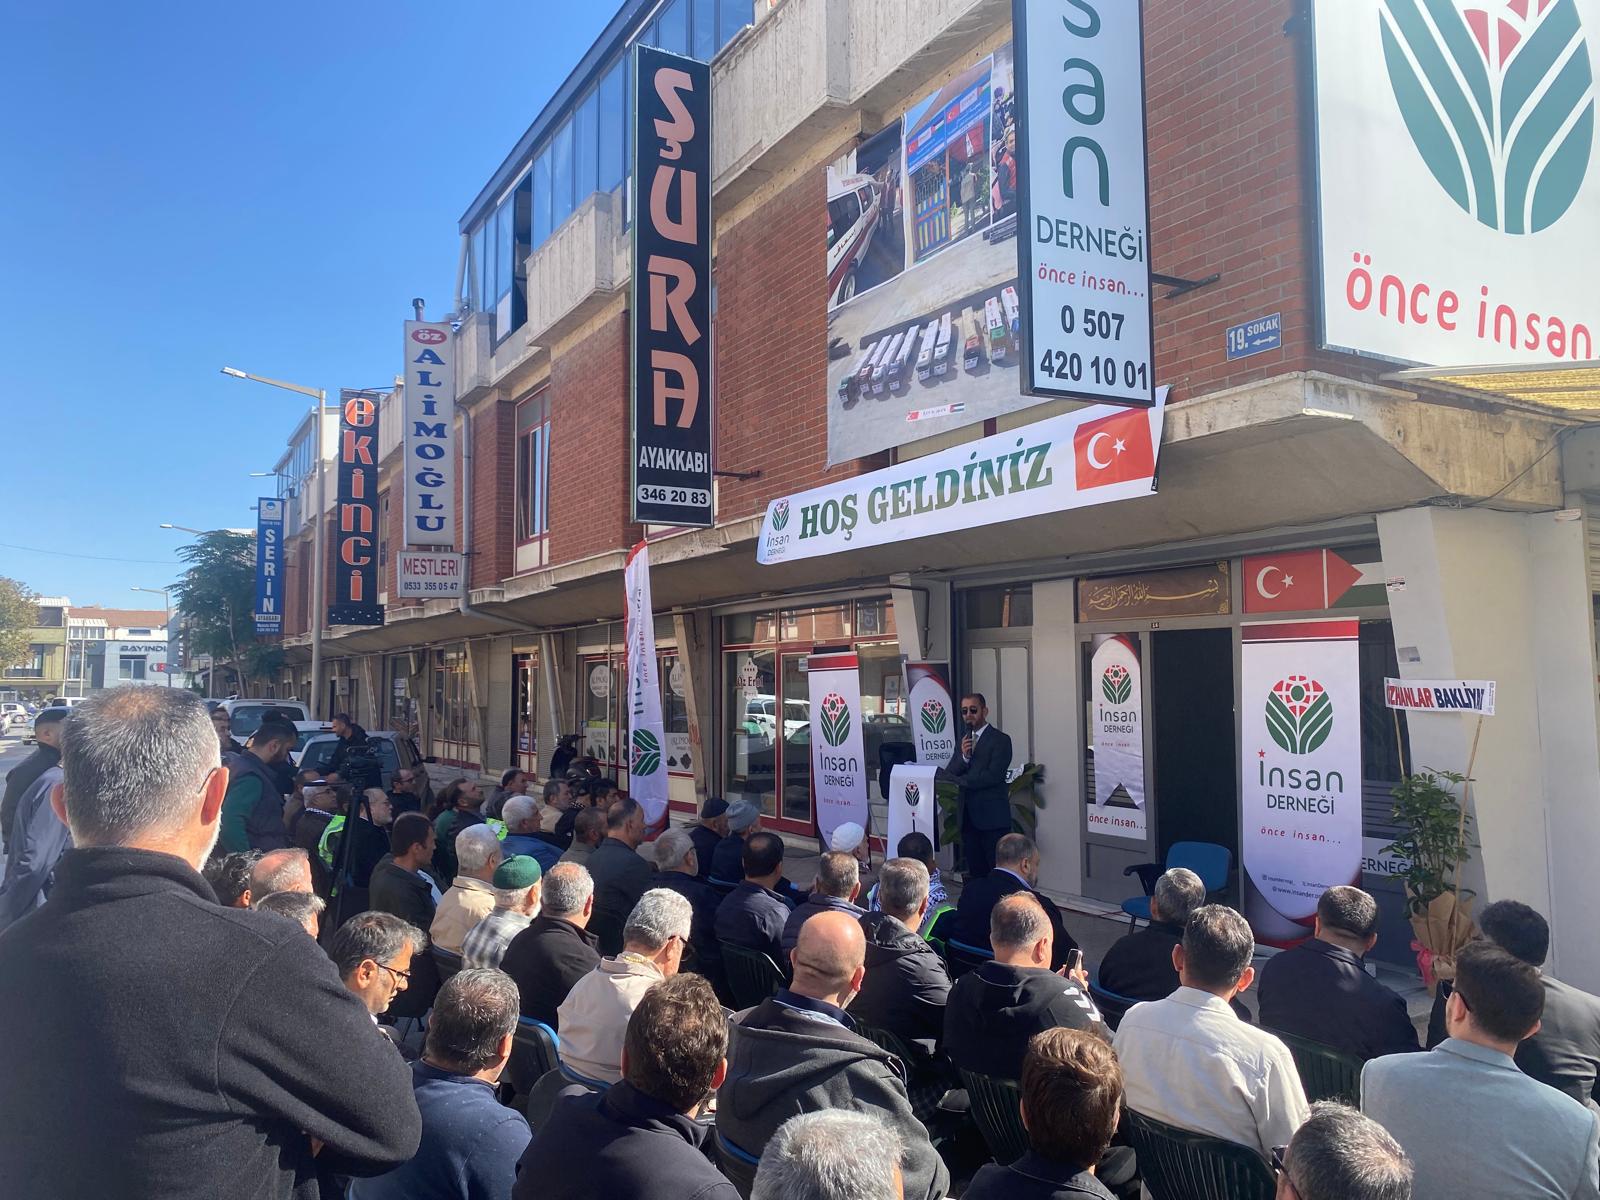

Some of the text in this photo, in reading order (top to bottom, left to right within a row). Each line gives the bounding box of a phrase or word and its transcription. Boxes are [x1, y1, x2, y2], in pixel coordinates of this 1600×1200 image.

[647, 67, 701, 429] ŞURA
[1036, 215, 1143, 262] DERNEĞİ
[1038, 263, 1144, 297] önce insan...
[1346, 252, 1592, 360] önce insan
[418, 329, 442, 341] ÖZ
[1061, 305, 1125, 341] 0 507
[1229, 317, 1278, 352] 19. SOKAK
[1040, 349, 1148, 390] 420 10 01
[413, 348, 448, 532] ALİMOĞLU
[639, 445, 708, 474] AYAKKABI
[641, 487, 707, 505] 346 20 83
[798, 437, 1053, 541] HOŞ GELDİNİZ
[262, 528, 276, 613] SERİN
[404, 581, 421, 591] 0533
[424, 581, 437, 591] 355
[449, 582, 458, 591] 47
[121, 645, 167, 653] BAYINDI
[1088, 813, 1109, 825] önce
[1266, 793, 1335, 815] DERNEĞİ
[1260, 826, 1286, 837] önce
[1362, 857, 1409, 874] ERNEĞ
[1277, 886, 1321, 899] www.insander.or
